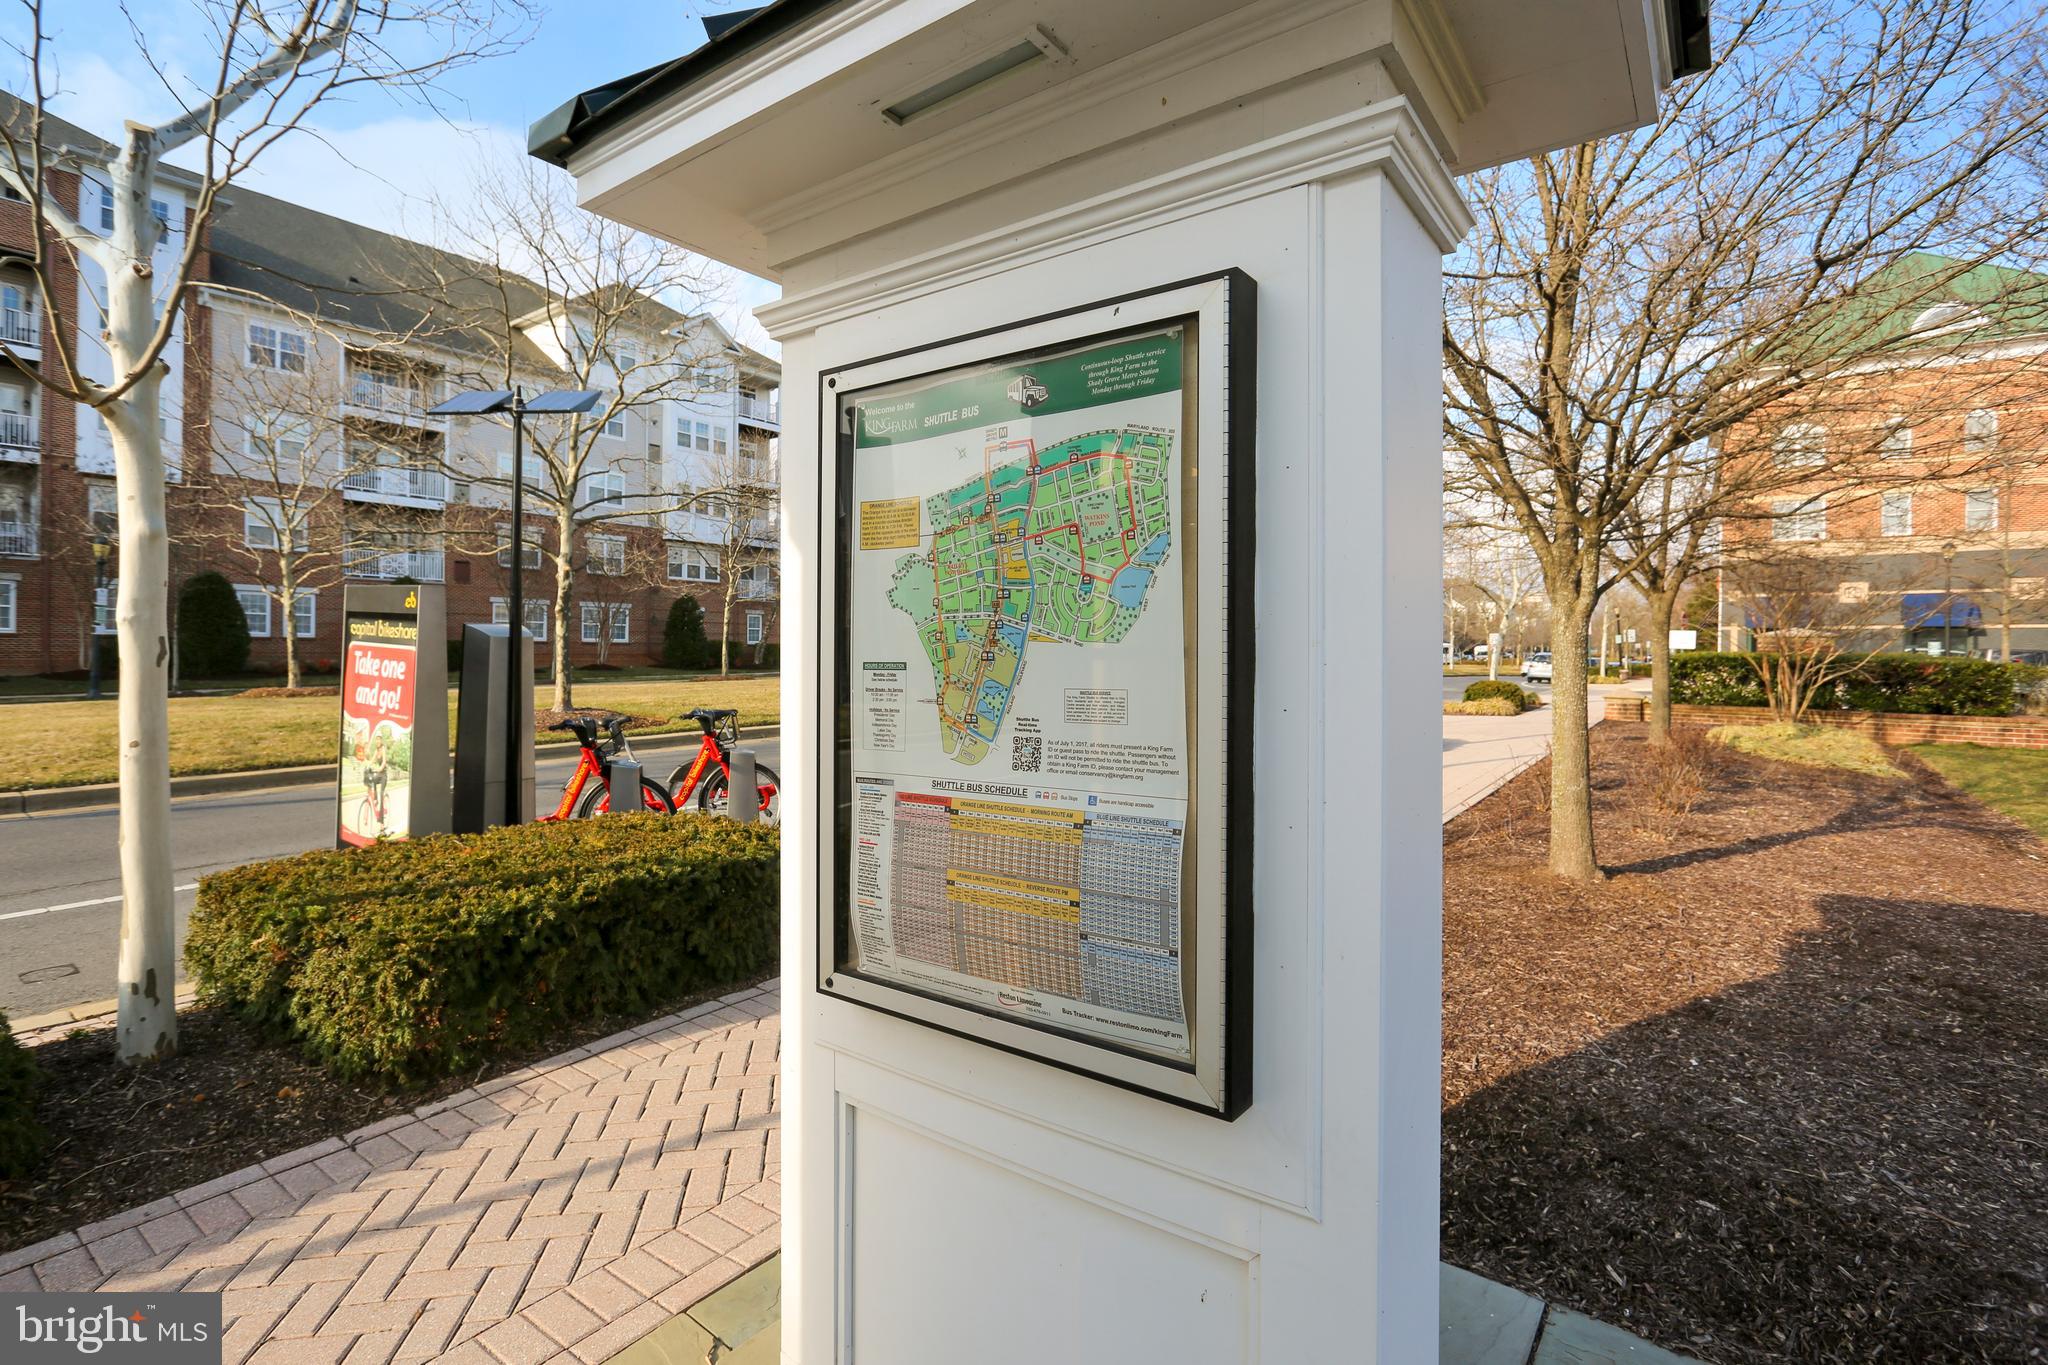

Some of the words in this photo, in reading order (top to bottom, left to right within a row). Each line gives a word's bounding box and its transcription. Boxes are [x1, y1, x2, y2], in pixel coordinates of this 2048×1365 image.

[1081, 357, 1124, 371] Continuous-loop
[1125, 352, 1144, 362] Shuttle
[1146, 348, 1166, 356] service
[1087, 379, 1103, 388] Shady
[1139, 368, 1159, 376] Station
[1088, 368, 1108, 378] through
[1110, 366, 1123, 374] King
[1091, 386, 1112, 395] Monday
[1113, 381, 1135, 390] through
[1136, 377, 1155, 386] Friday
[865, 406, 896, 416] Welcome
[905, 402, 915, 410] the
[924, 410, 958, 428] SHUTTLE
[961, 405, 980, 419] BUS
[350, 621, 377, 639] capital
[378, 620, 417, 640] bikeshare
[354, 650, 380, 676] Take
[382, 659, 406, 680] one
[356, 681, 379, 707] and
[379, 685, 402, 714] go!
[680, 778, 694, 800] capital
[692, 750, 709, 778] bikeshare
[559, 794, 572, 818] capital
[571, 762, 588, 794] bikeshare
[932, 780, 964, 790] SHUTTLE
[985, 786, 1028, 796] SCHEDULE
[1000, 879, 1021, 888] SCHEDULE
[1026, 884, 1045, 893] REVERSE
[1074, 1010, 1094, 1021] Tracker:
